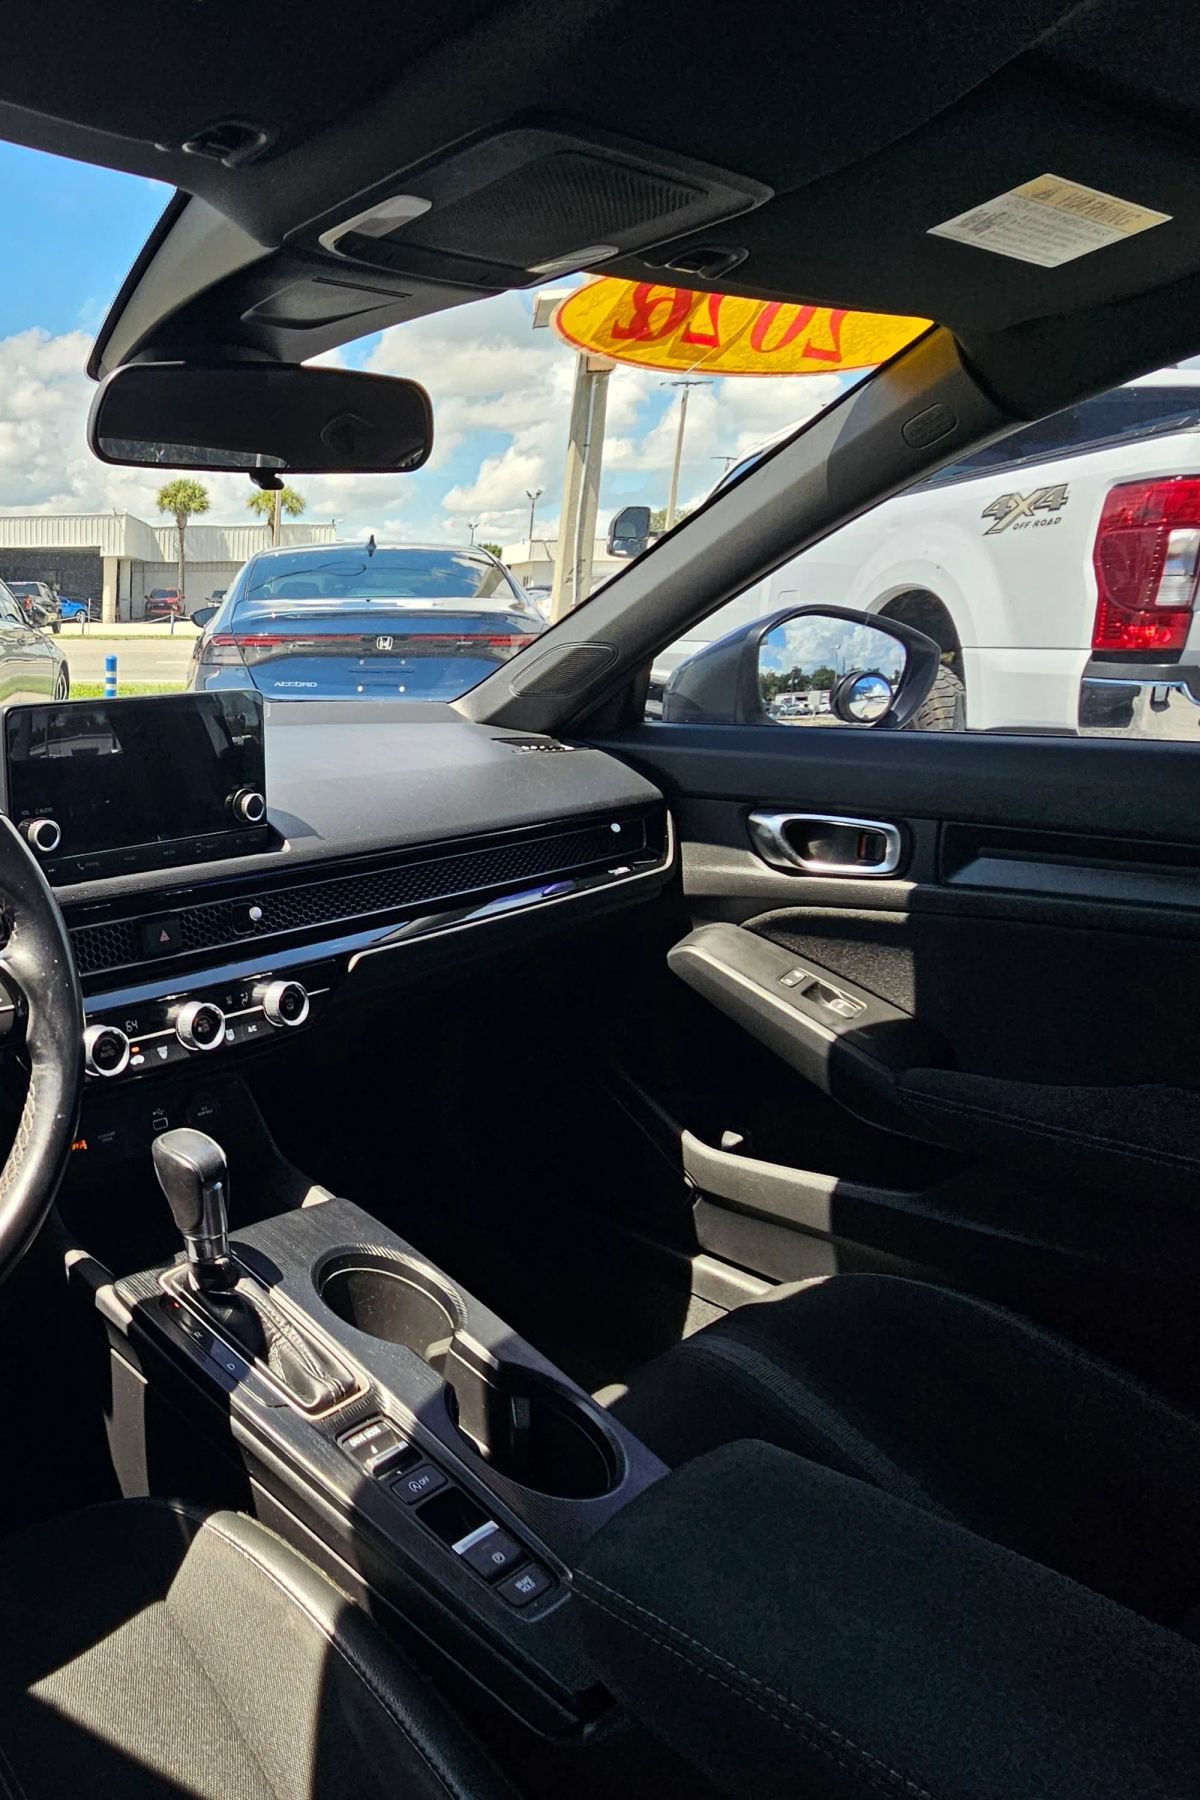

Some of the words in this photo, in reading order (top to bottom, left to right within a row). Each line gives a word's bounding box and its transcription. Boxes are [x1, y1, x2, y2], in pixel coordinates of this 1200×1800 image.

[1013, 520, 1031, 531] OFF
[1034, 517, 1062, 528] ROAD
[226, 1362, 236, 1371] D
